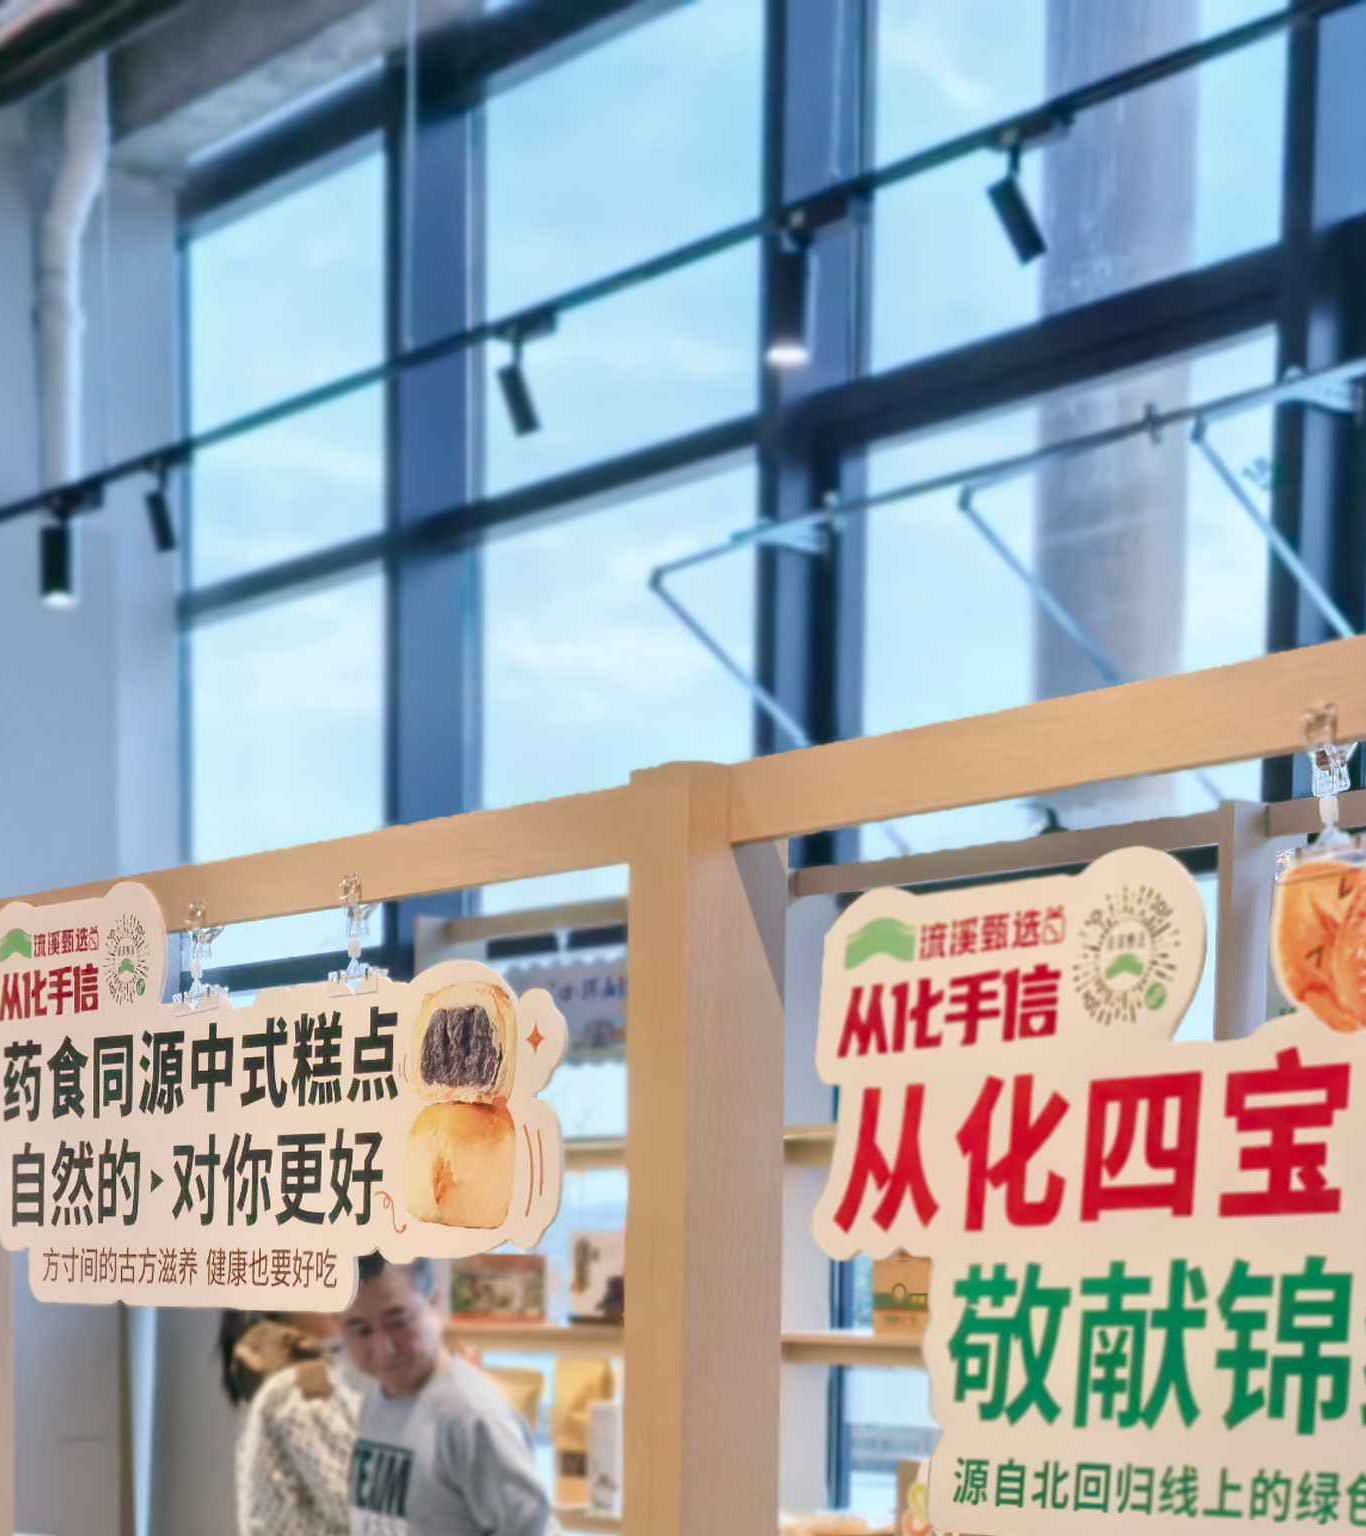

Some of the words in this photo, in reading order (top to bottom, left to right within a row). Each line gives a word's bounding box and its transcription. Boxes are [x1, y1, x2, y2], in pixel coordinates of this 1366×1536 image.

[919, 908, 1041, 961] 流溪甄选
[0, 962, 99, 1021] 从化手信
[837, 963, 1062, 1058] 从化手信
[2, 1006, 399, 1122] 药食同源中式糕点
[10, 1140, 141, 1228] 自然的
[171, 1127, 384, 1227] 对你更好
[832, 1046, 1351, 1235] 从化四宝
[42, 1246, 199, 1287] 方寸间的古方滋养
[206, 1248, 338, 1288] 健康也要好吃
